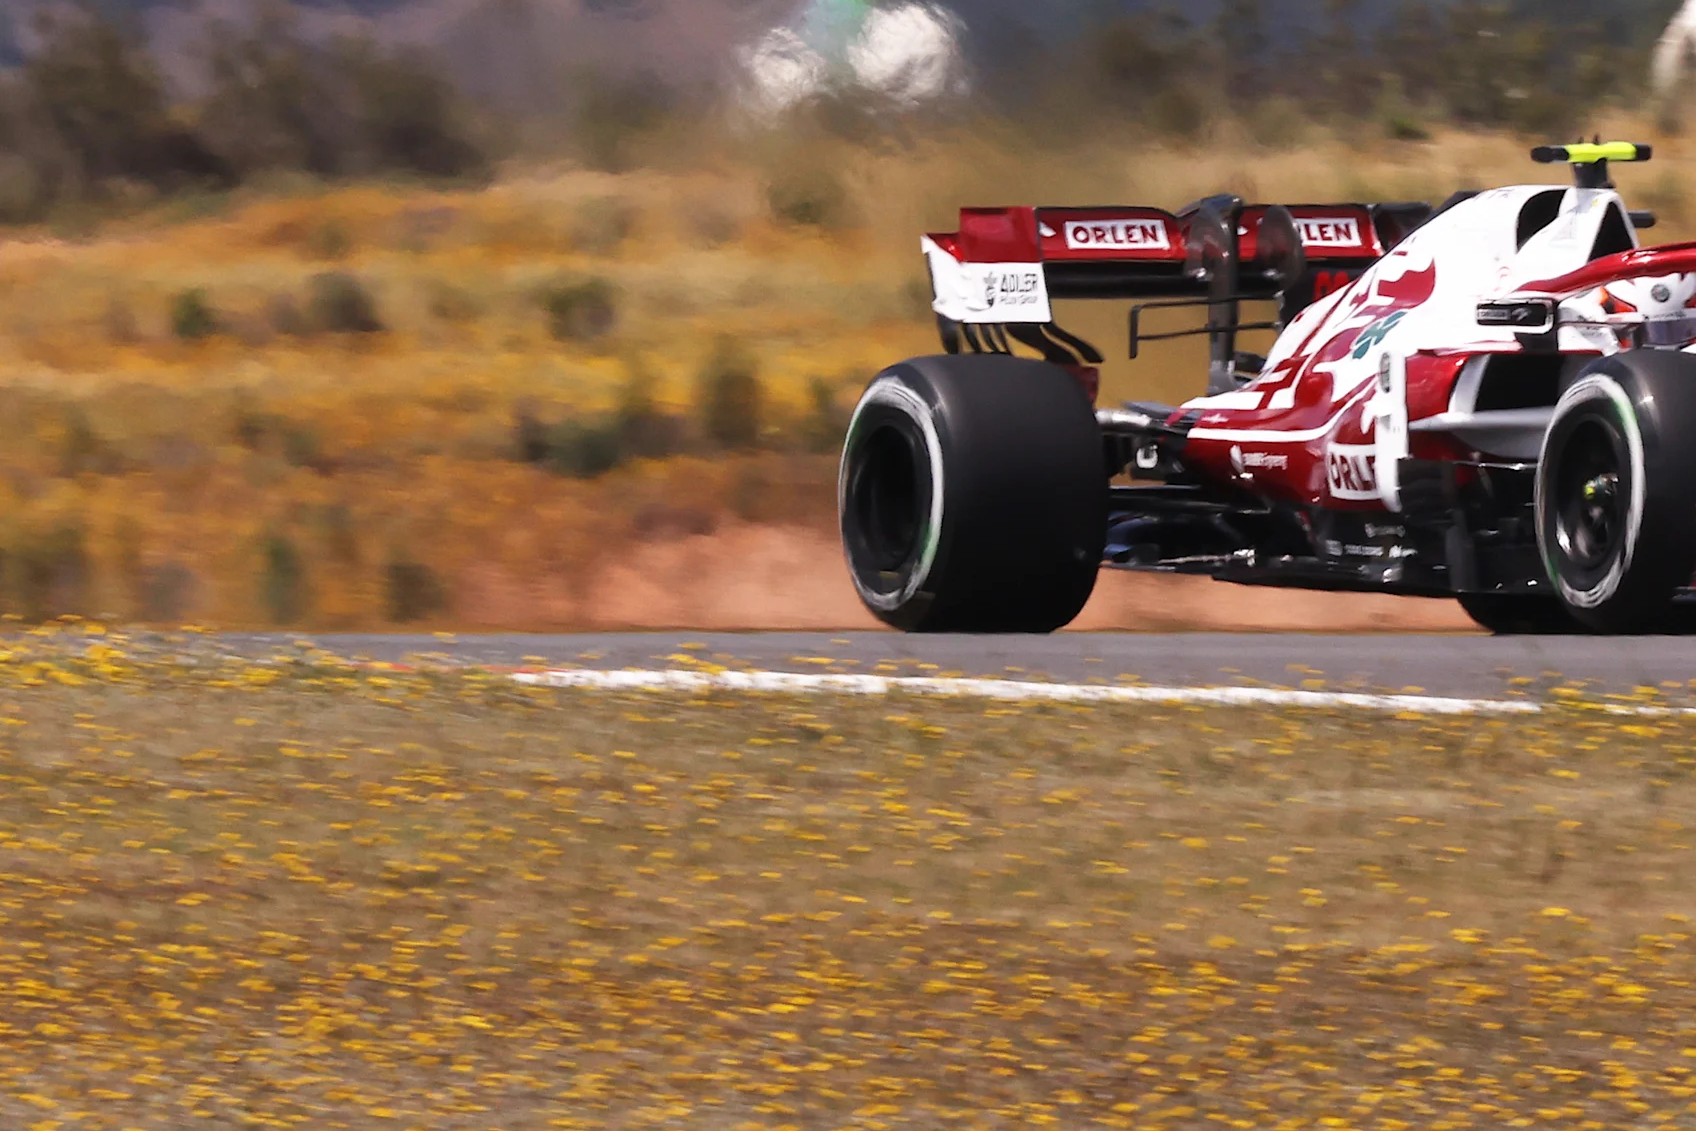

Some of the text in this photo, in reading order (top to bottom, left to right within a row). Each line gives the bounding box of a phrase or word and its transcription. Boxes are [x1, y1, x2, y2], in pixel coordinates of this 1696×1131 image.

[1073, 225, 1159, 243] ORLEN
[1302, 223, 1353, 241] LEN
[1328, 453, 1376, 491] ORL
